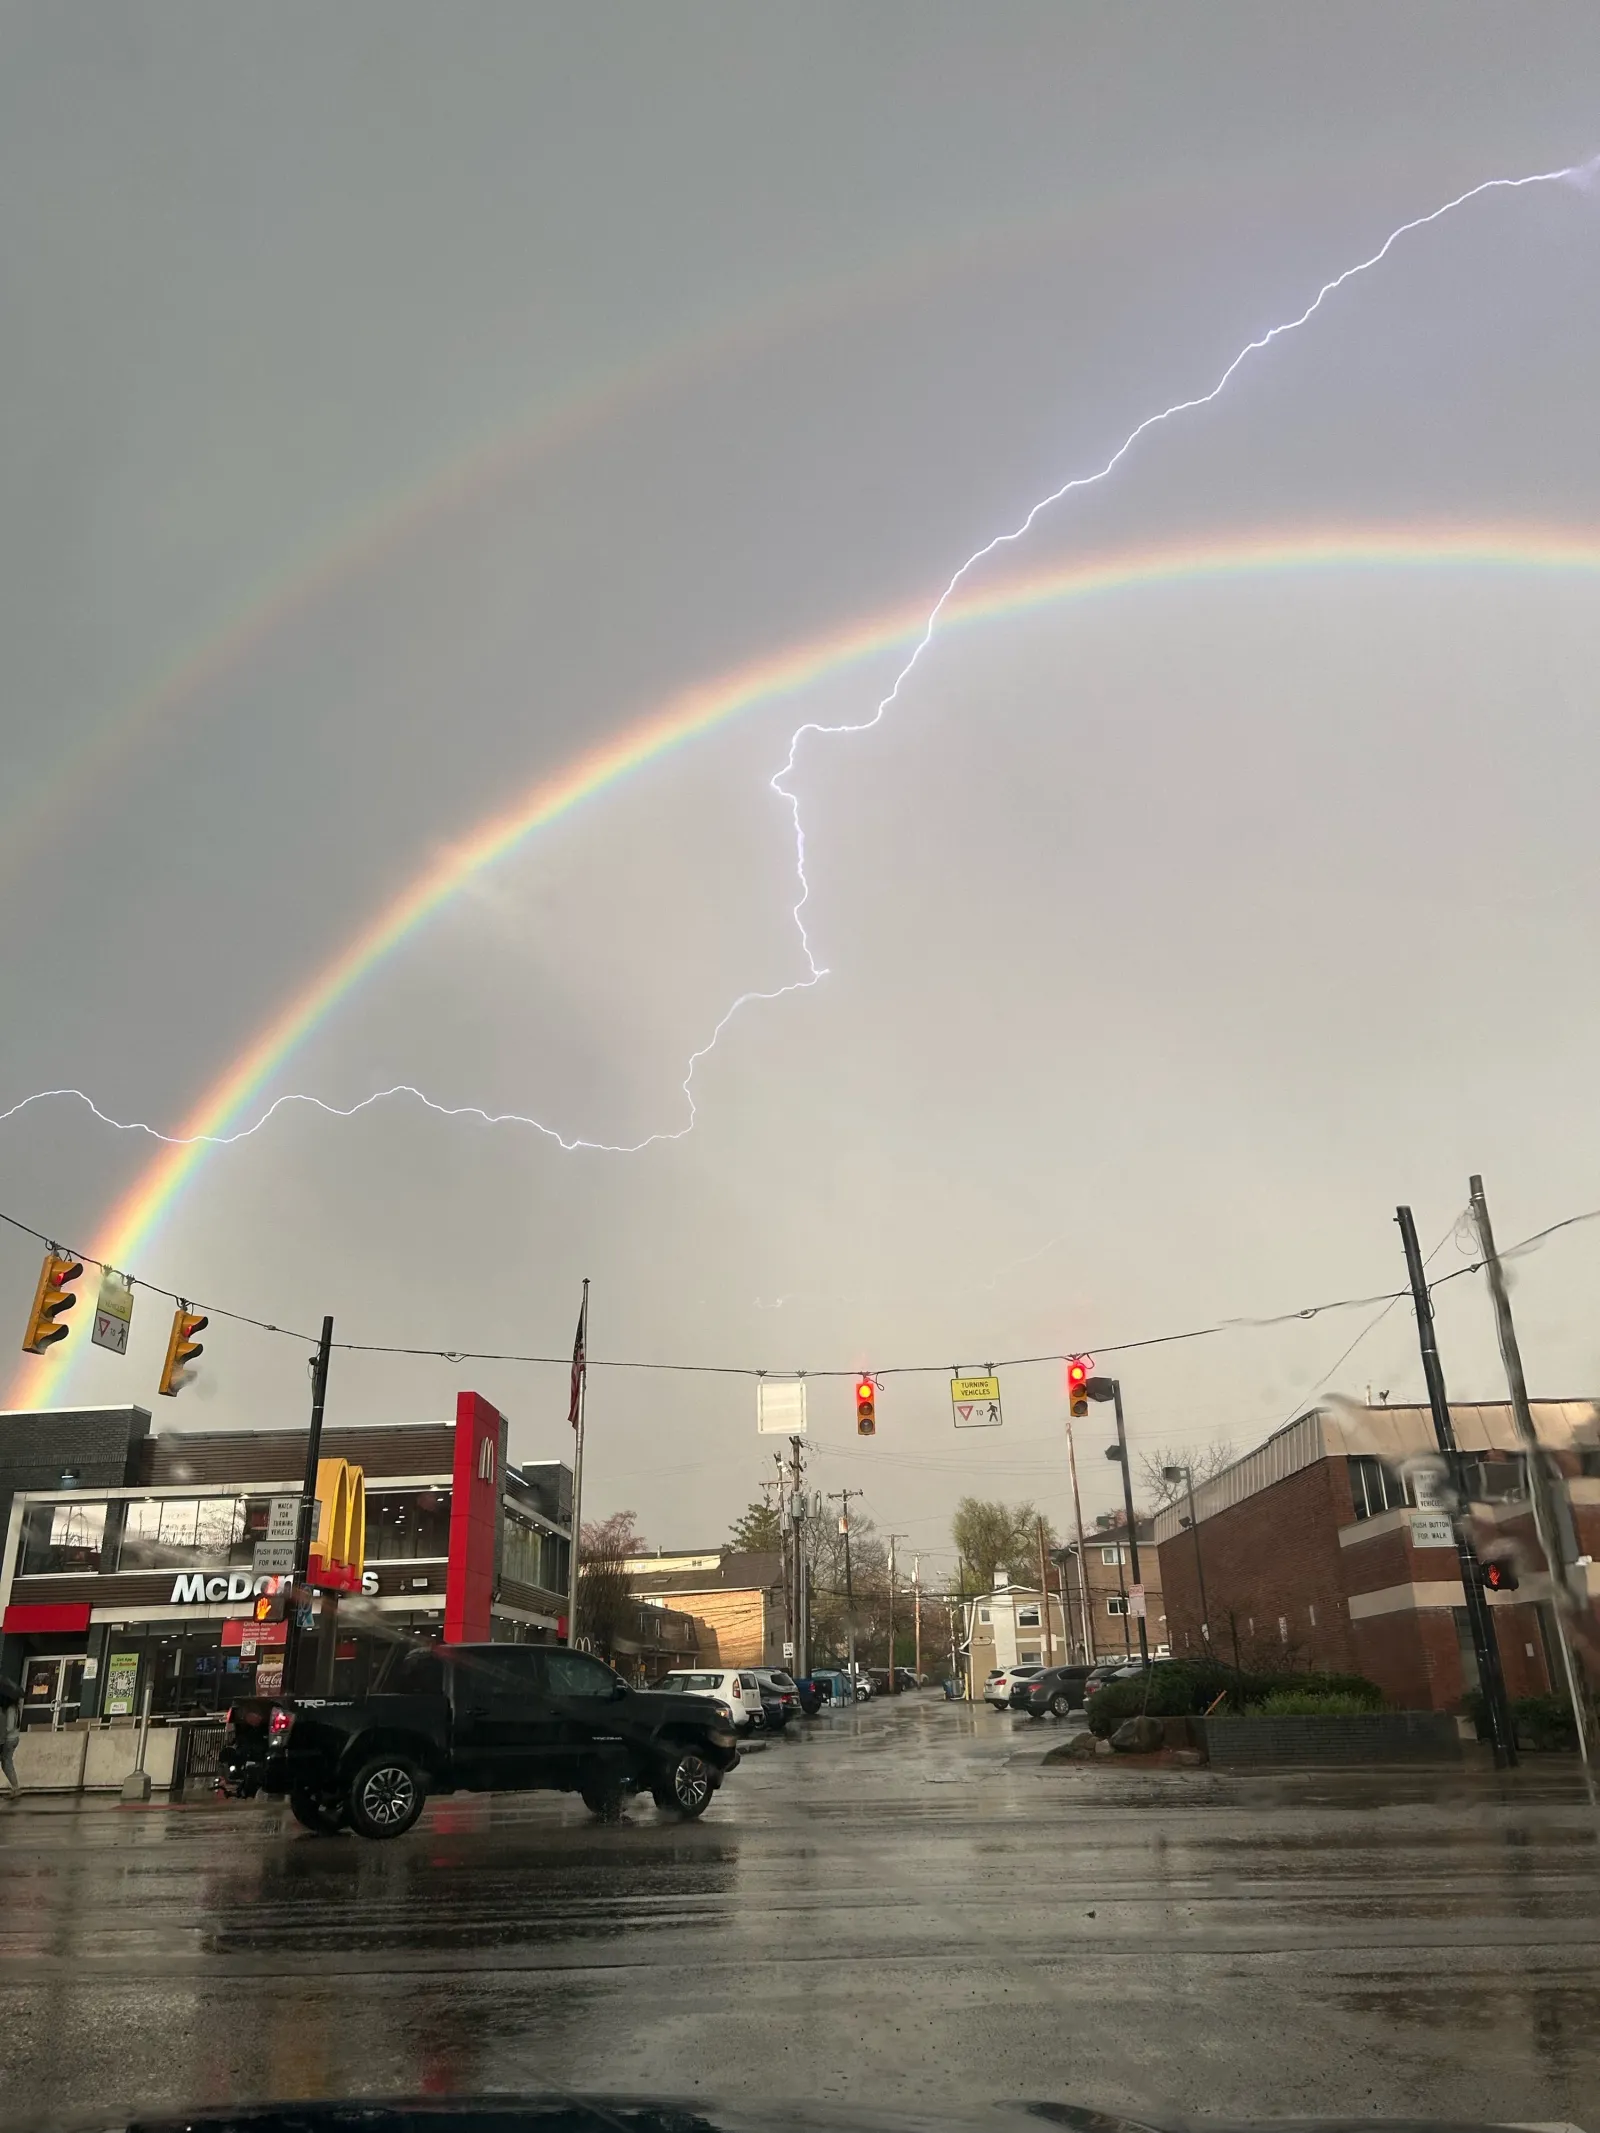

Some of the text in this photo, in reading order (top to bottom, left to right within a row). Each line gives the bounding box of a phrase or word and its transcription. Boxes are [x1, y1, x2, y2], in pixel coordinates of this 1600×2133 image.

[277, 1502, 293, 1510] WATCH
[279, 1511, 289, 1519] FOR
[1412, 1521, 1449, 1529] PUSH BUTTON
[1417, 1532, 1447, 1540] FOR WALK
[256, 1548, 293, 1556] PUSH BUTTON
[258, 1559, 270, 1567] FOR
[170, 1571, 379, 1603] McDons
